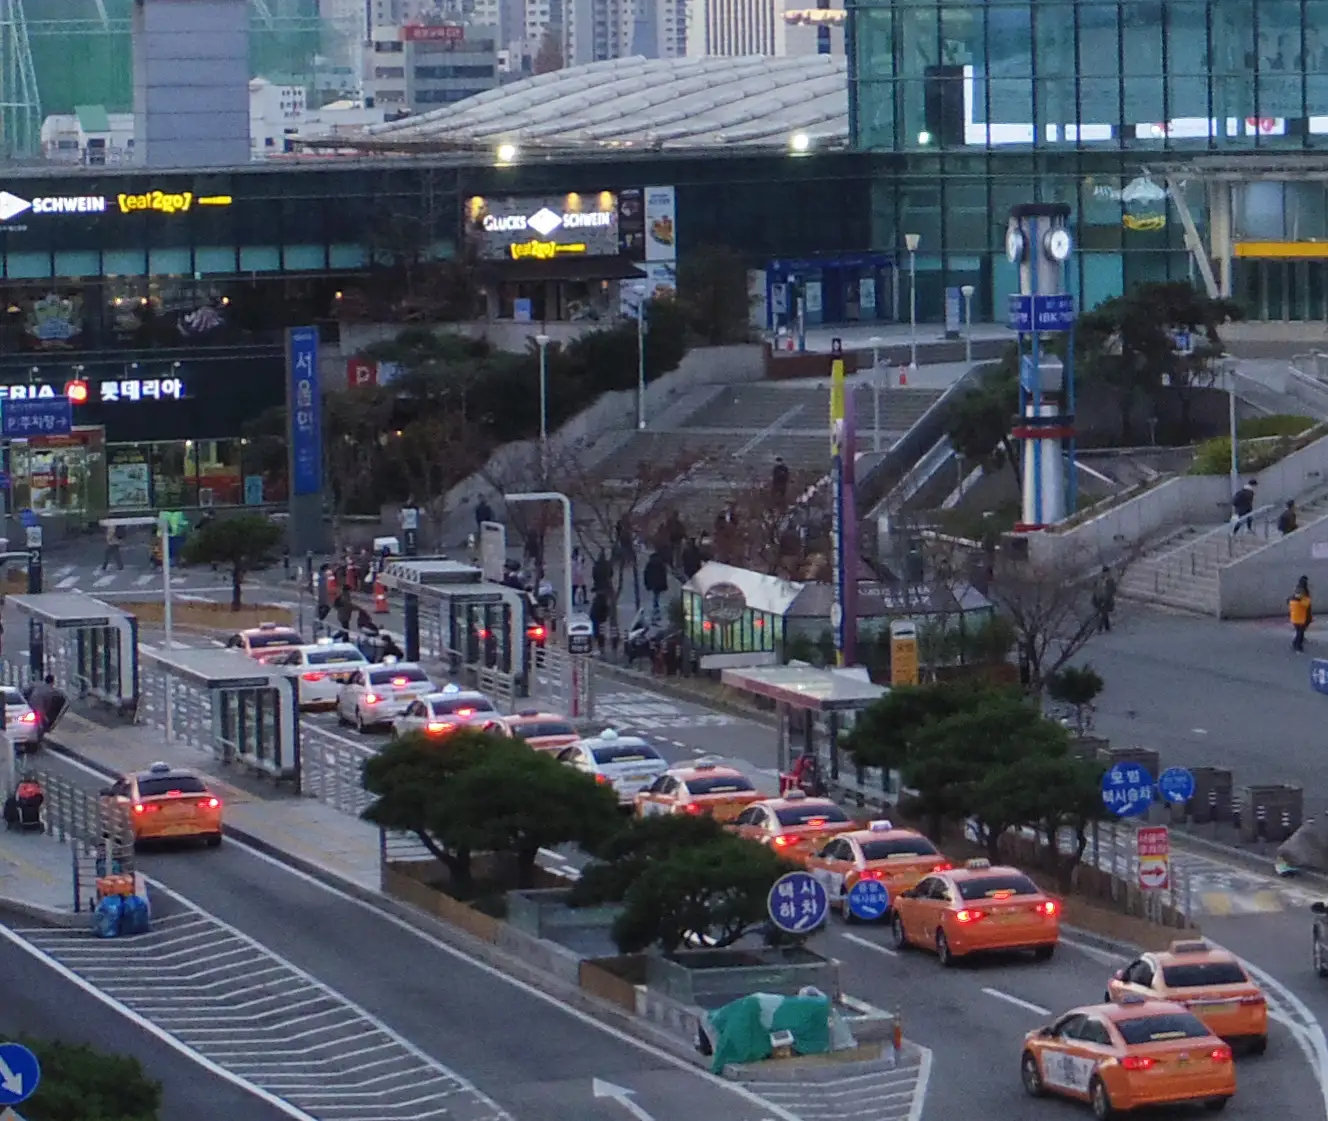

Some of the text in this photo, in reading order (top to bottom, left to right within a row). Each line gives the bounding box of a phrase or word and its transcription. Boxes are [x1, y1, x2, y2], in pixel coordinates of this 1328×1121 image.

[32, 196, 105, 213] SCHWEIN
[101, 378, 183, 402] 롯데리아
[1102, 784, 1151, 804] 택시승차
[778, 879, 817, 899] 택시
[780, 899, 817, 918] 하차
